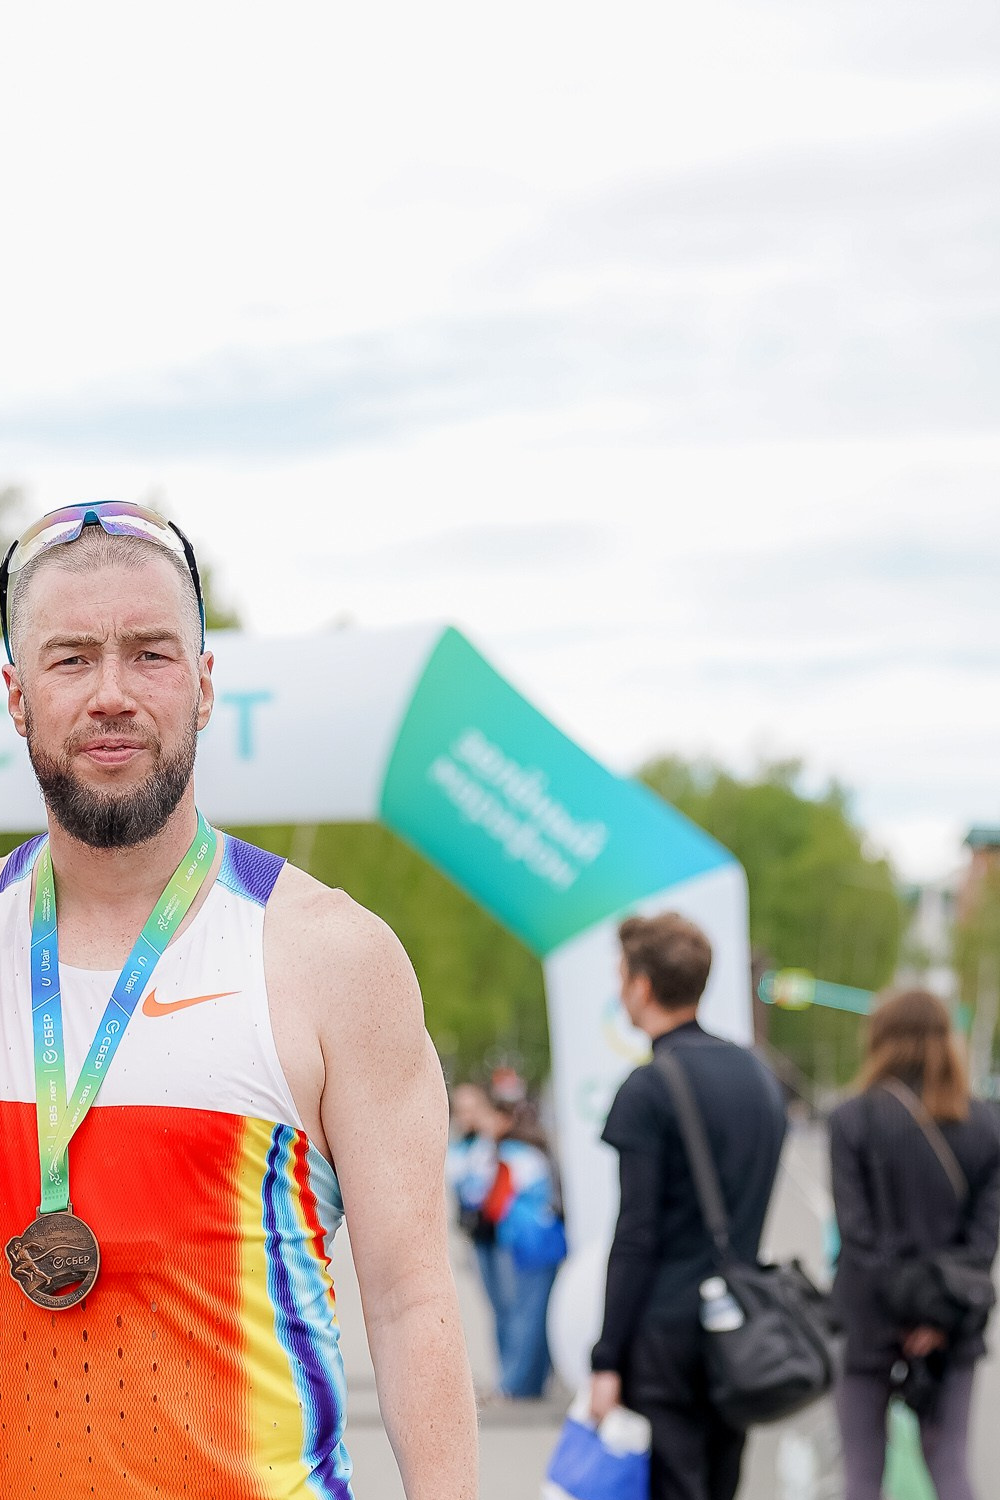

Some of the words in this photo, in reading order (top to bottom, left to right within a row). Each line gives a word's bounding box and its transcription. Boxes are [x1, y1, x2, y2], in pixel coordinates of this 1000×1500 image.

[197, 842, 209, 861] 185
[41, 949, 50, 972] Utair
[124, 970, 141, 994] Utair
[43, 1013, 55, 1046] СБЕР
[95, 1036, 112, 1070] СБЕР
[79, 1083, 92, 1105] 185
[50, 1105, 58, 1127] 185
[65, 1255, 90, 1266] СБЕР
